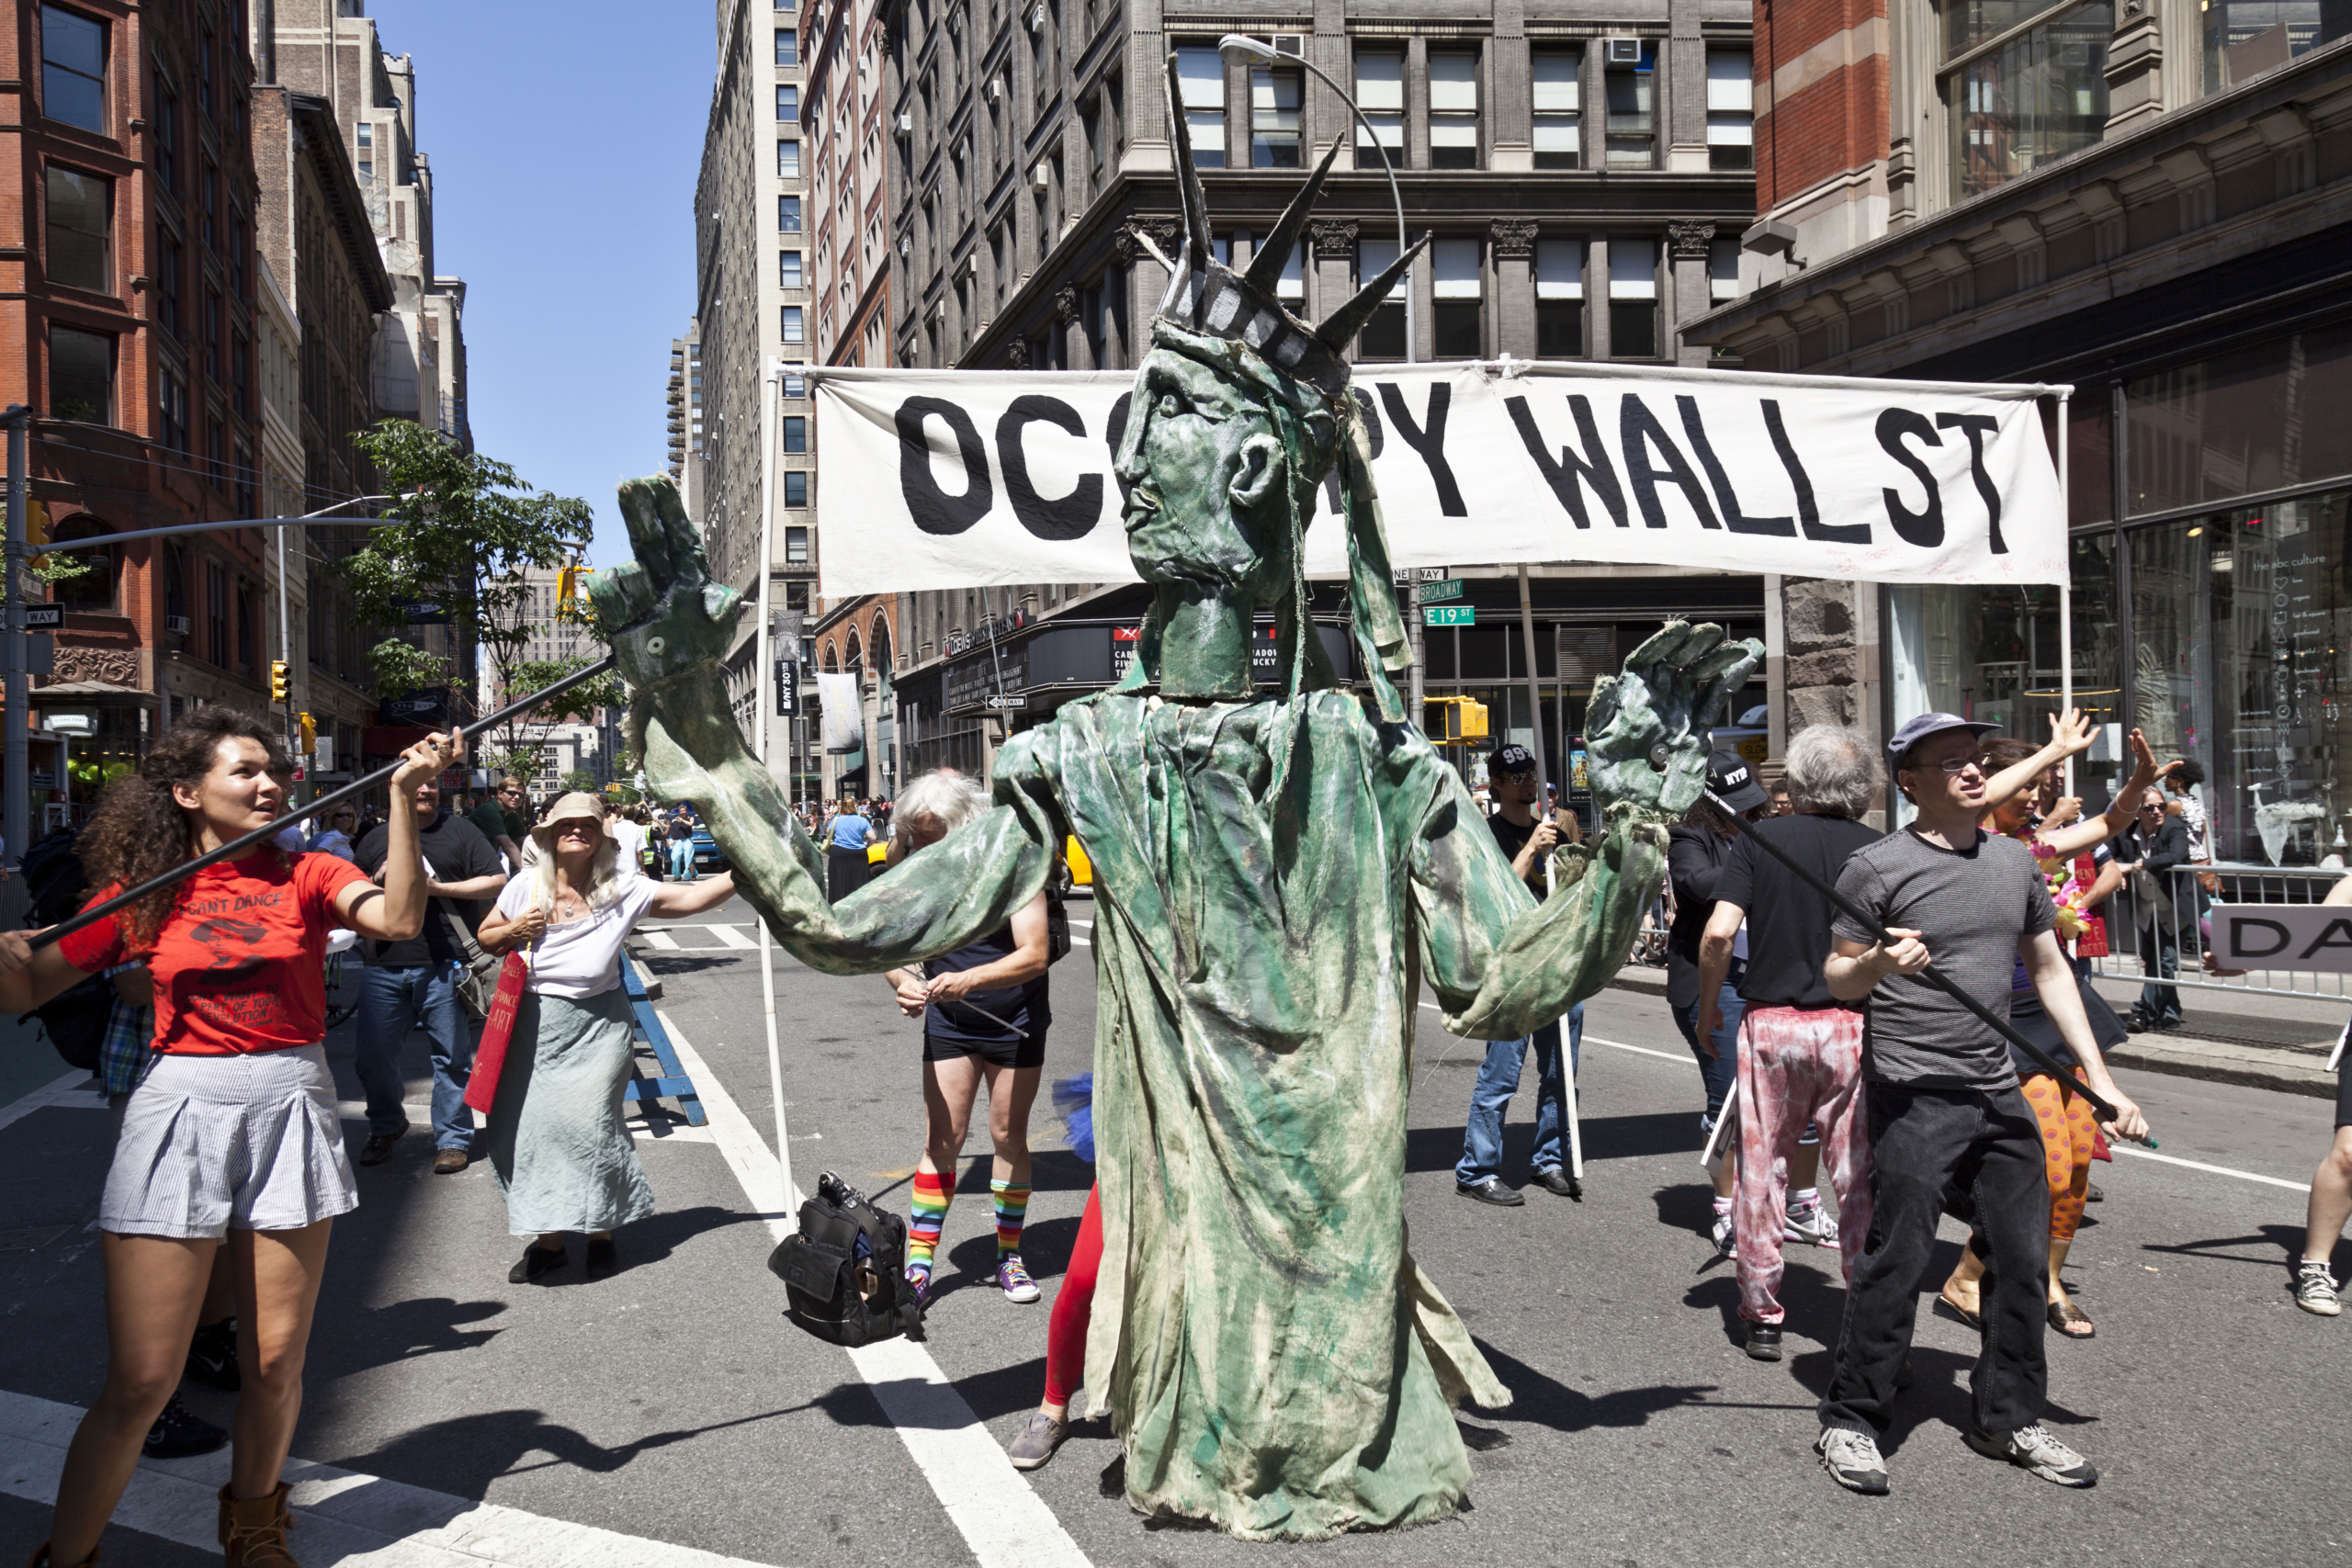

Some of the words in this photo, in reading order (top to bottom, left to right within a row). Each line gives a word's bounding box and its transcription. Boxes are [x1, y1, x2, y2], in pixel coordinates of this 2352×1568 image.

[1503, 392, 1872, 546] WALL
[1874, 407, 2009, 555] ST
[2254, 559, 2269, 571] the
[2271, 557, 2290, 569] abc
[2291, 553, 2326, 567] culture
[1393, 570, 1408, 580] NE
[1420, 580, 1462, 602] BROADWAY
[29, 611, 54, 623] WAY
[1427, 609, 1436, 624] E
[1440, 609, 1457, 624] 19
[950, 634, 970, 655] LOEWS
[1114, 650, 1132, 659] CAB
[782, 672, 791, 685] 30
[831, 680, 850, 743] craftbar
[1745, 744, 1767, 753] SLOW
[187, 898, 229, 915] CAN'T
[2076, 942, 2109, 956] IBERTY
[223, 987, 259, 1002] WANT
[266, 983, 280, 995] TO
[200, 1001, 228, 1013] PART
[232, 1000, 248, 1012] OF
[253, 994, 280, 1010] YOUR
